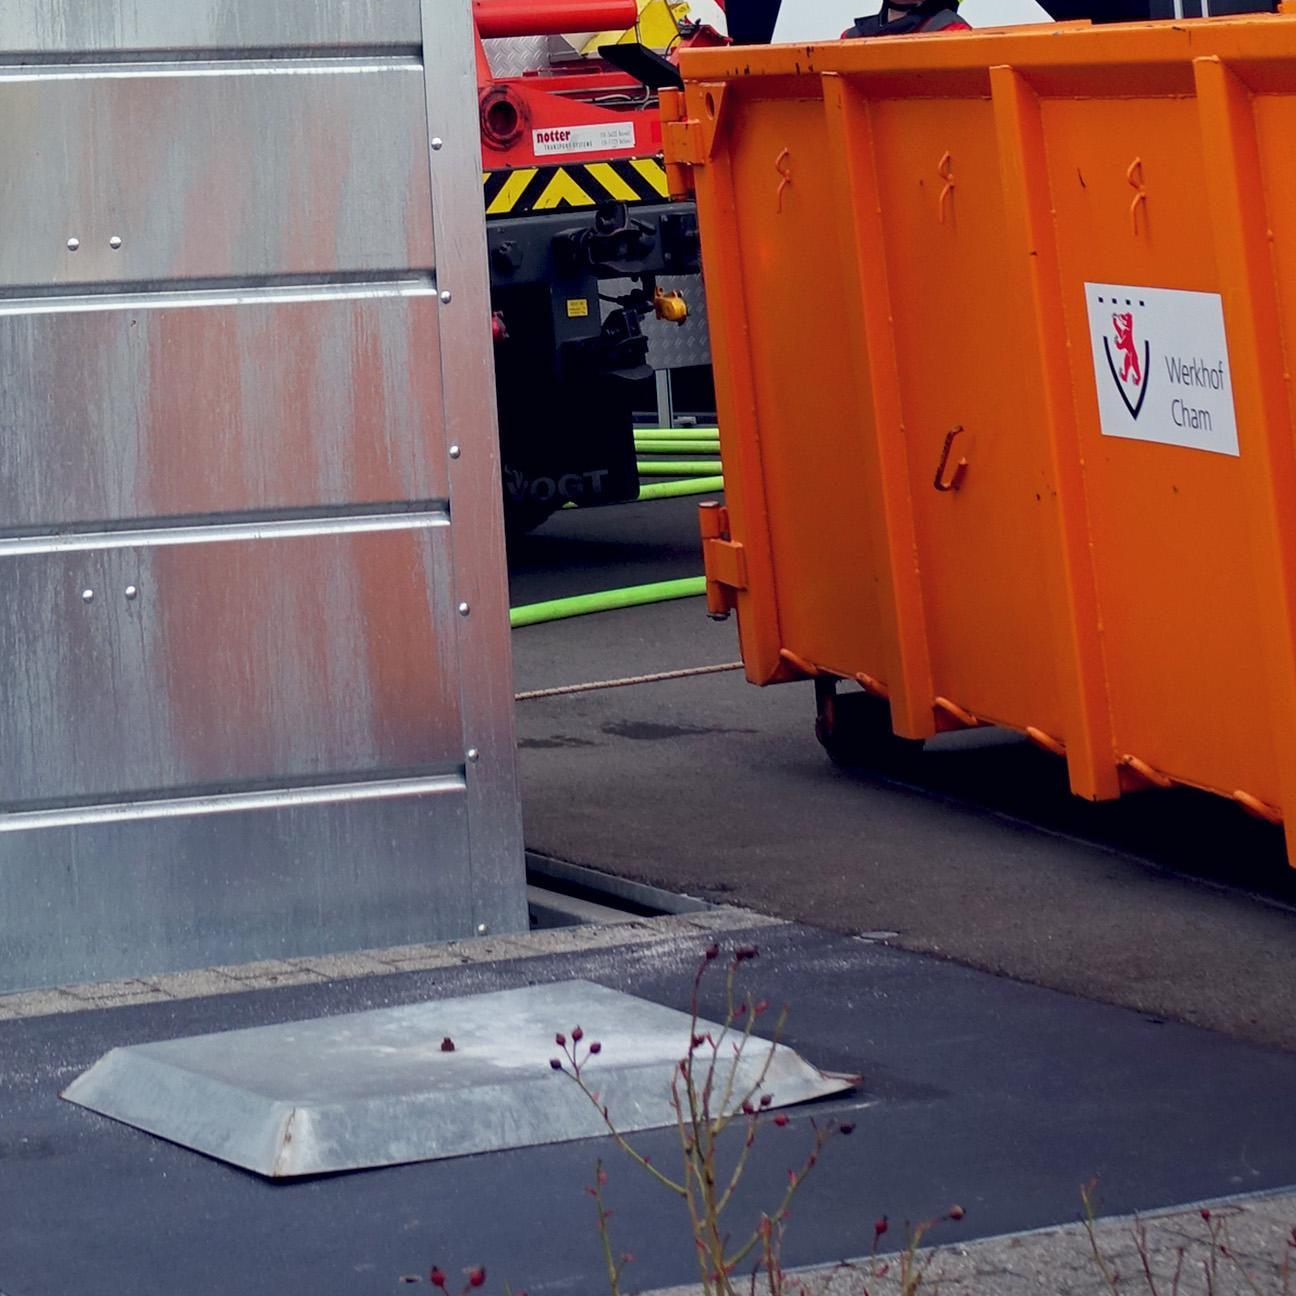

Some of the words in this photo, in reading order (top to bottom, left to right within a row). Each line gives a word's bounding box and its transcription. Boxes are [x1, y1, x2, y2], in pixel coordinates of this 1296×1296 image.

[536, 129, 571, 144] notter
[1164, 355, 1225, 391] Werkhof
[1170, 398, 1213, 432] Cham
